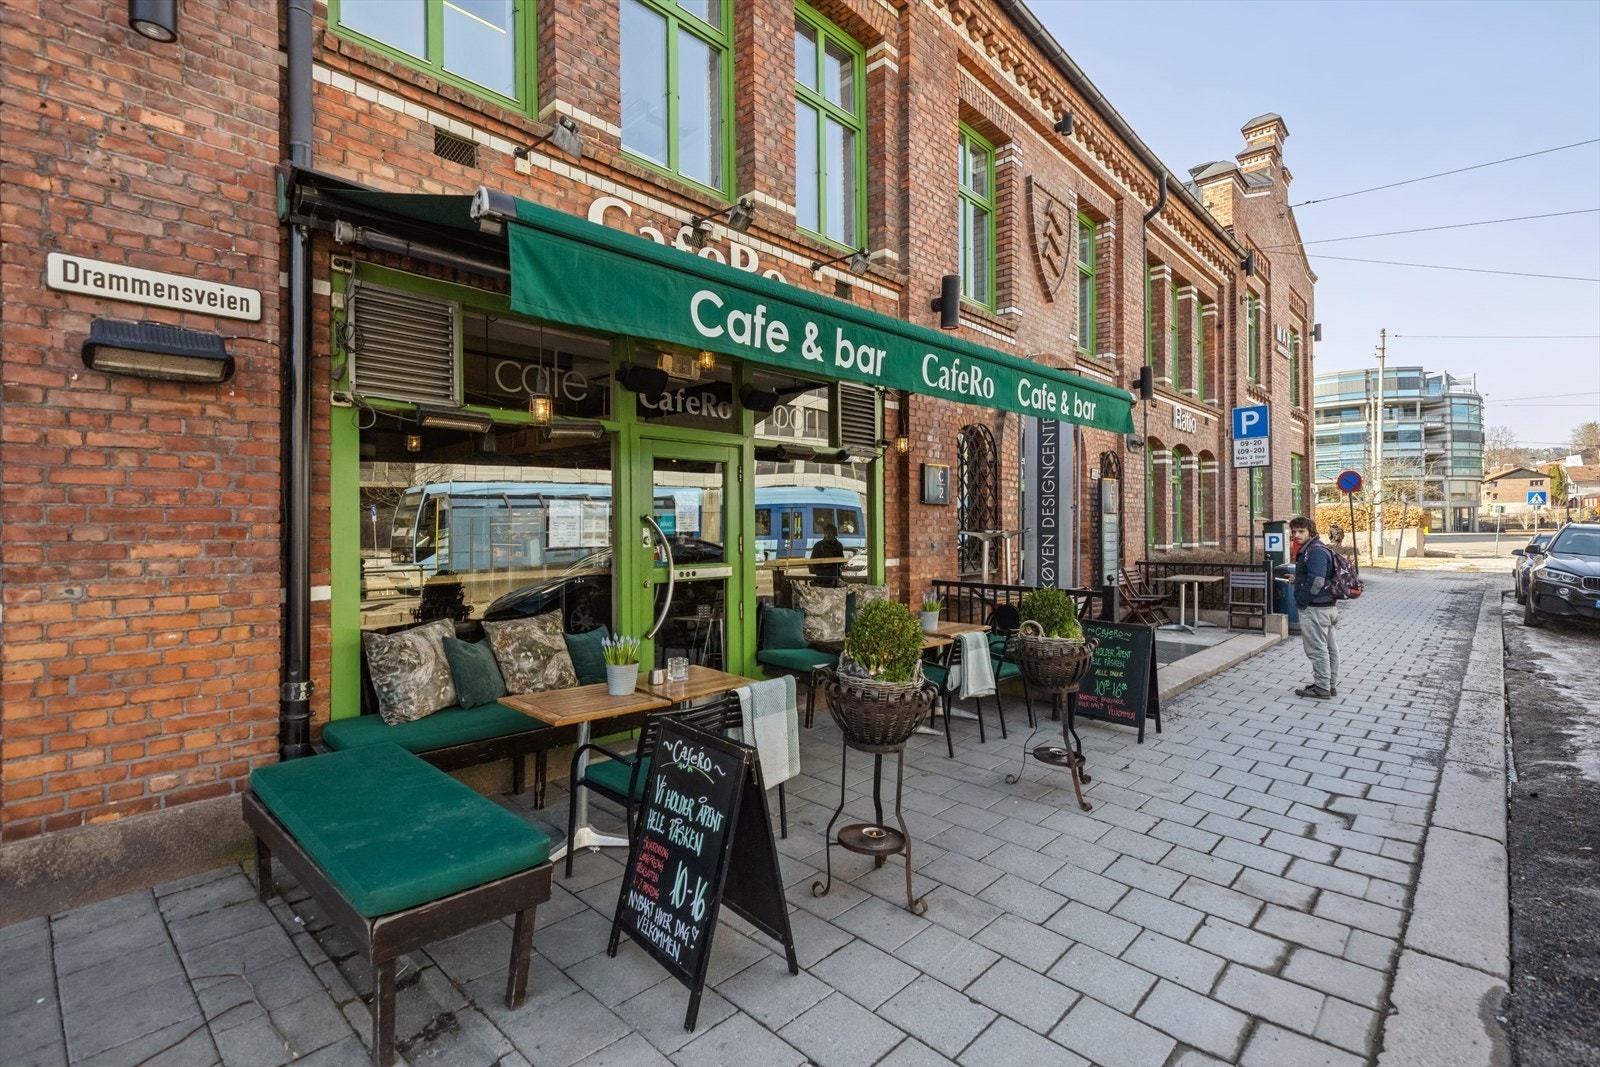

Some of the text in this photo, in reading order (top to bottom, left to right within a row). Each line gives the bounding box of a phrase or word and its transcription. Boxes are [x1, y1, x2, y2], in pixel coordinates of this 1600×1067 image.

[62, 259, 250, 313] Drammensveien
[690, 289, 887, 377] Cafe & bar
[495, 345, 588, 402] cafe
[921, 353, 995, 399] CafeRo
[1017, 378, 1097, 421] Cafe & bar
[1174, 405, 1197, 434] Ratio
[1241, 410, 1260, 435] P
[938, 470, 944, 482] C
[938, 487, 944, 499] 2
[1268, 535, 1280, 549] P
[646, 808, 665, 835] HELE
[668, 817, 704, 856] PÅSKEN
[664, 789, 695, 822] HOLDER
[695, 796, 725, 832] ÅPENT
[627, 889, 656, 919] NYBAKT
[654, 907, 673, 934] HVER
